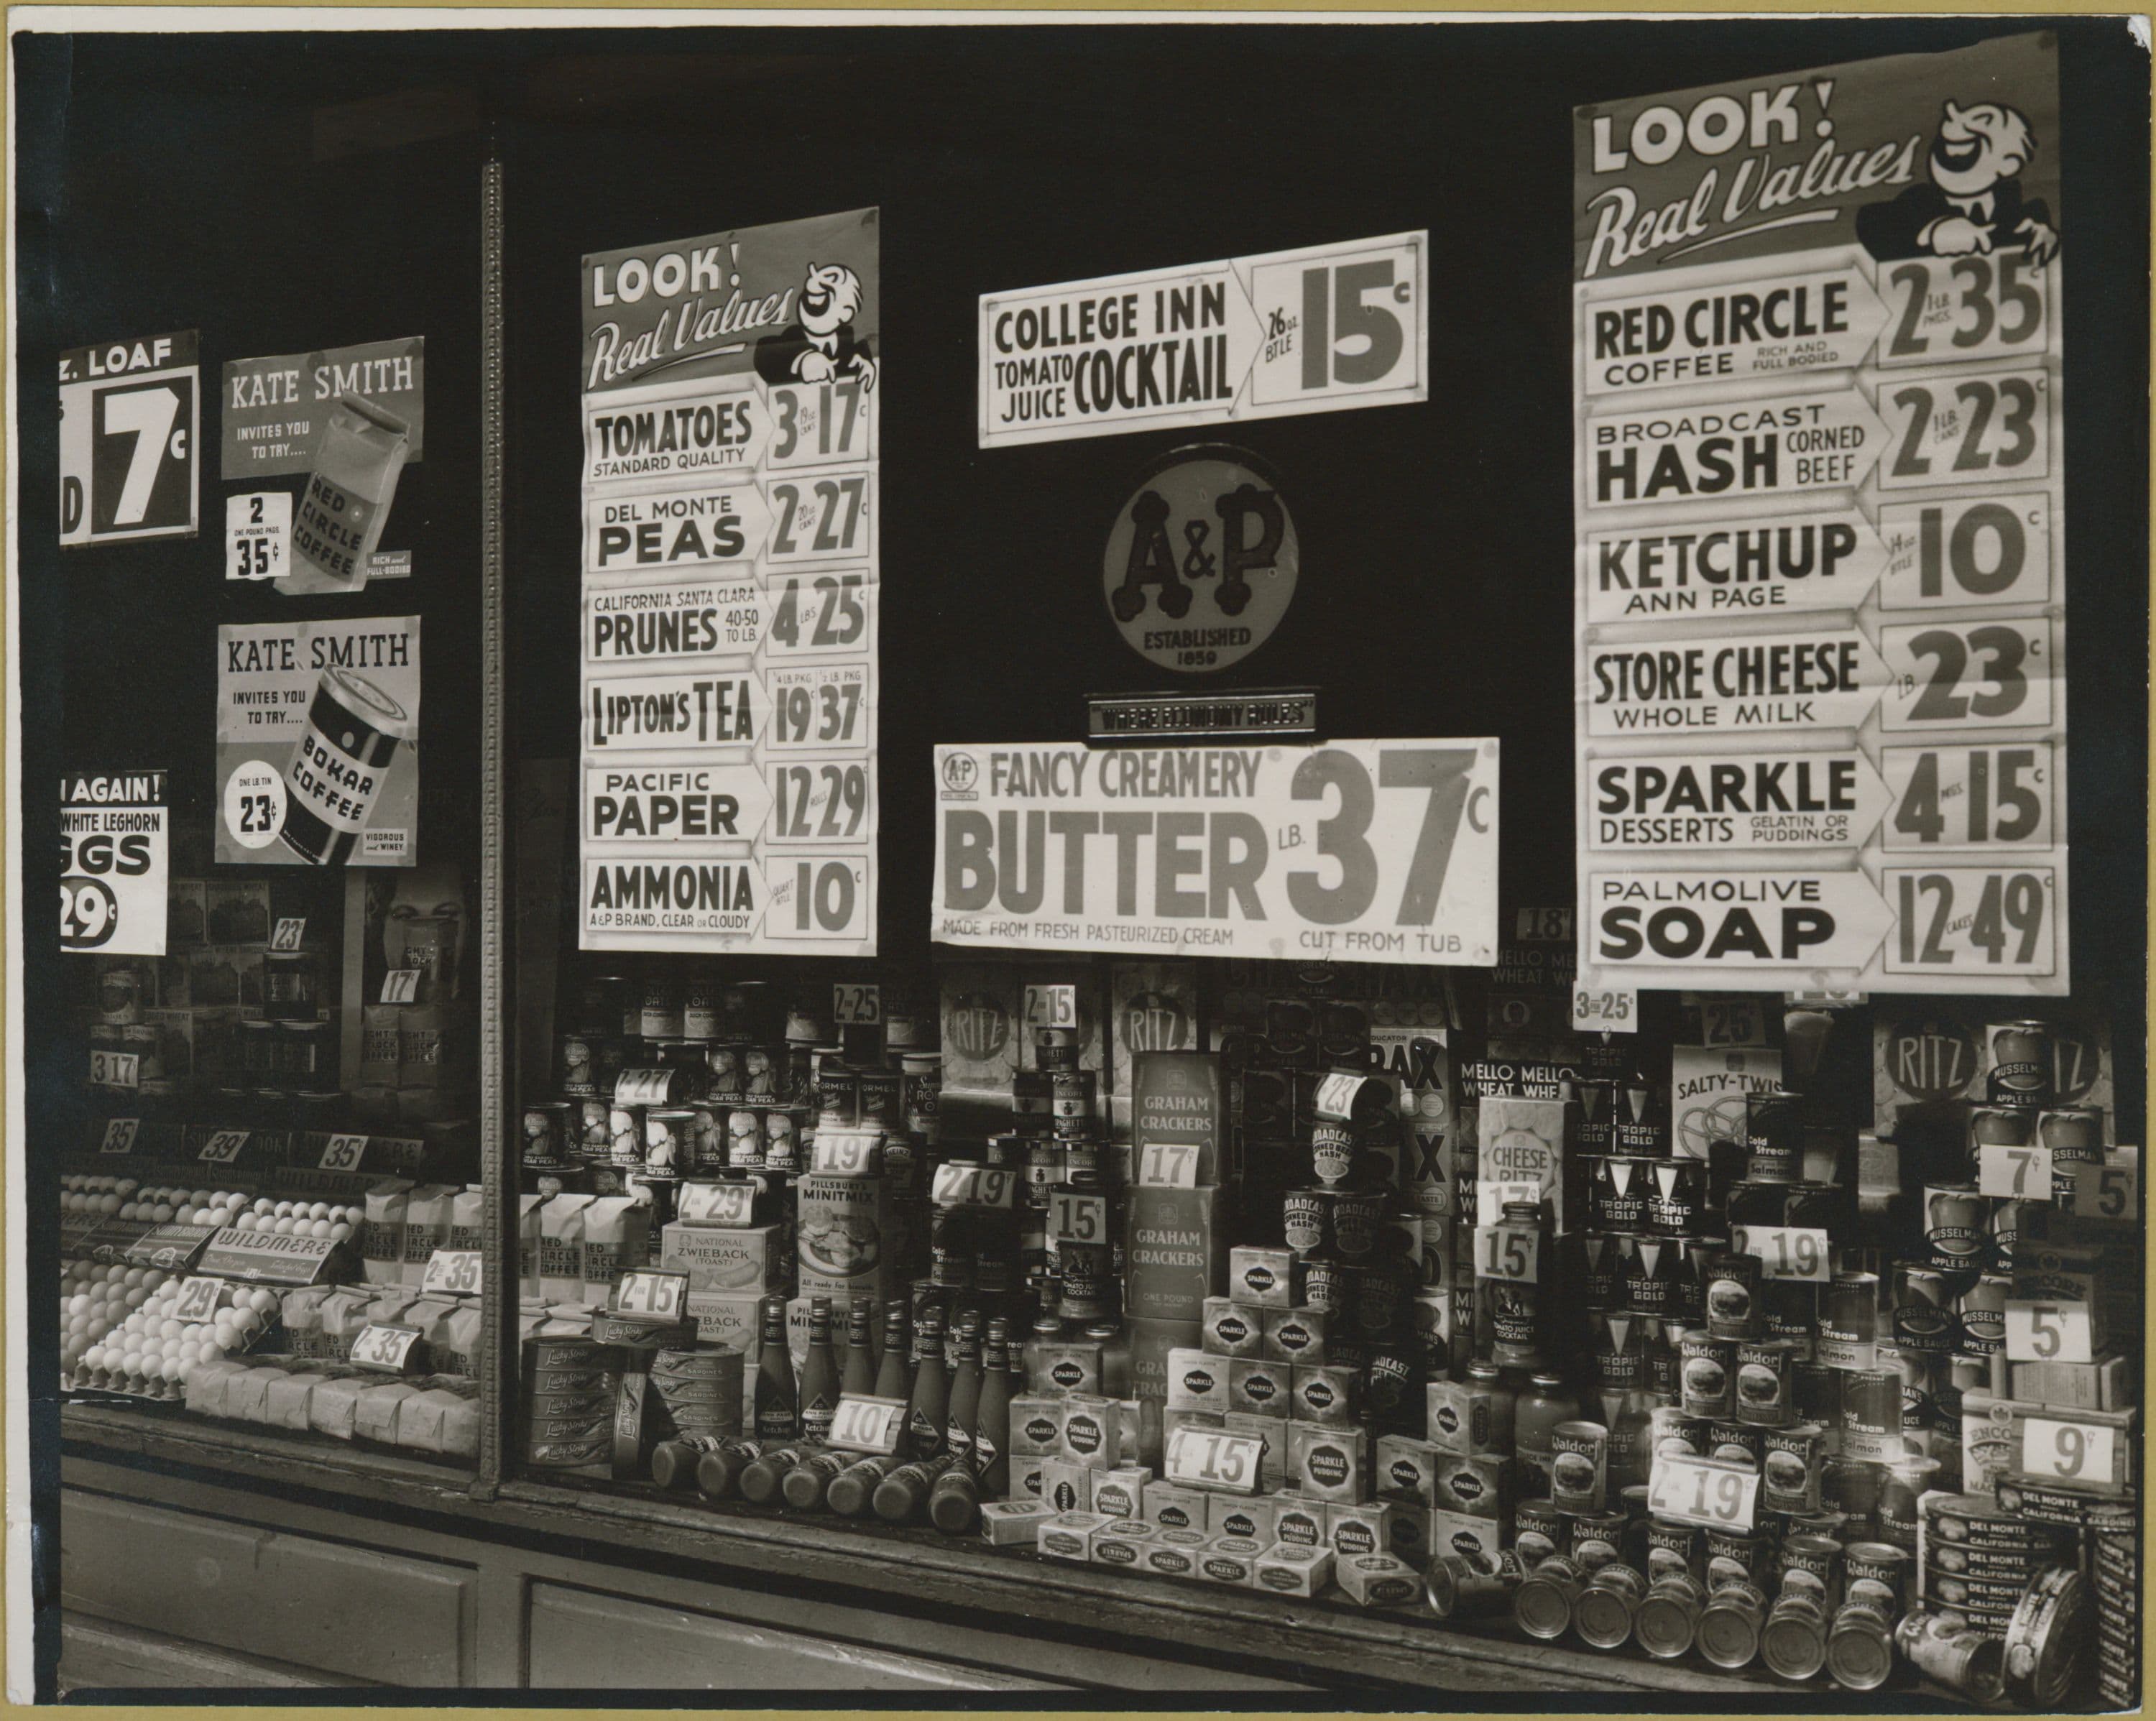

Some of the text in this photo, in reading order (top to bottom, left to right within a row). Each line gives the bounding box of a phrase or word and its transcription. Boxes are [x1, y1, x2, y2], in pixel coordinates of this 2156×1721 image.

[1593, 80, 1835, 175] LOOK!
[1583, 133, 1921, 279] Real Values
[594, 242, 740, 308] LOOK!
[995, 282, 1225, 354] COLLEGE INN
[1594, 281, 1848, 360] RED CIRCLE
[587, 287, 794, 390] Real Values
[1265, 334, 1292, 364] BTLE
[1758, 341, 1828, 358] RICH AND
[88, 338, 173, 377] LOAF
[1604, 352, 1735, 386] COFFEE
[1752, 351, 1838, 371] FULL BODIED
[231, 356, 413, 408] KATE SMITH
[995, 353, 1074, 390] TOMATO
[1075, 333, 1233, 414] COCKTAIL
[1001, 387, 1066, 423] JUICE
[237, 421, 310, 440] INVITES YOU
[596, 400, 751, 458] TOMATOES
[1596, 404, 1825, 445] BROADCAST
[1786, 425, 1865, 453] CORNED
[252, 446, 267, 459] TO
[594, 448, 745, 477] STANDARD QUALITY
[1596, 433, 1778, 502] HASH
[1797, 453, 1856, 484] BEEF
[311, 477, 346, 513] RED
[249, 497, 264, 523] 2
[605, 495, 732, 523] DEL MONTE
[234, 528, 244, 537] ONE
[246, 527, 264, 536] POUND
[302, 502, 363, 551] CIRCLE
[292, 524, 354, 576] COFFEE
[598, 515, 745, 567] PEAS
[1112, 482, 1285, 623] A&P
[372, 554, 390, 566] RICH
[1599, 522, 1857, 591] KETCHUP
[594, 587, 755, 612] CALIFORNIA SANTA CLARA
[1625, 585, 1787, 614] ANN PAGE
[594, 607, 718, 657] PRUNES
[726, 629, 740, 642] TO
[1144, 627, 1251, 650] ESTABLISHED
[228, 633, 410, 673] KATE SMITH
[1177, 650, 1217, 665] 1859
[1593, 640, 1859, 704] STORE CHEESE
[233, 690, 305, 705] INVITES YOU
[248, 711, 262, 724] TO
[693, 680, 753, 742] TEA
[1164, 704, 1244, 729] ECONOMY
[1614, 701, 1816, 729] WHOLE MILK
[303, 734, 374, 797] BOKAR
[990, 749, 1263, 798] FANCY CREAMERY
[239, 778, 252, 788] ONE
[262, 777, 272, 786] TIN
[292, 762, 364, 821] COFFEE
[606, 772, 709, 793] PACIFIC
[1596, 760, 1856, 816] SPARKLE
[60, 813, 160, 833] WHITE LEGHORN
[594, 794, 739, 836] PAPER
[1750, 815, 1848, 829] GELATIN OR
[367, 833, 404, 841] VIGOROUS
[1600, 817, 1734, 844] DESSERTS
[1752, 828, 1848, 843] PUDDINGS
[944, 810, 1268, 921] BUTTER
[590, 865, 754, 911] AMMONIA
[1603, 880, 1821, 902] PALMOLIVE
[662, 914, 694, 928] CLEAR
[708, 914, 750, 928] CLOUDY
[942, 918, 1233, 946] MADE FROM FRESH PASTEURIZED CREAM
[1599, 906, 1836, 960] SOAP
[1299, 931, 1462, 954] CUT FROM TUB
[955, 1010, 1002, 1051] RITZ
[1130, 1008, 1176, 1051] RITZ
[1461, 1063, 1514, 1079] MELLO
[1899, 1035, 1963, 1089] RITZ
[1144, 1096, 1209, 1111] GRAHAM
[1140, 1116, 1212, 1132] CRACKERS
[1493, 1148, 1547, 1168] CHEESE
[803, 1189, 873, 1202] MINITMIX
[1600, 1200, 1644, 1212] TROPIC
[1606, 1210, 1637, 1221] GOLD
[217, 1228, 332, 1256] WILDMERE
[696, 1237, 744, 1247] NATIONAL
[1136, 1229, 1201, 1245] GRAHAM
[677, 1247, 750, 1260] ZWIEBACK
[1133, 1250, 1204, 1267] CRACKERS
[1247, 1274, 1273, 1285] SPARKLE
[1163, 1295, 1194, 1304] POUND
[1219, 1325, 1245, 1337] SPARKLE
[1737, 1348, 1782, 1373] Waldorf
[1054, 1369, 1082, 1380] SPARKLE
[1848, 1421, 1885, 1434] Stream
[1552, 1436, 1600, 1459] Waldorf
[1765, 1436, 1812, 1459] Waldorf
[1312, 1456, 1345, 1469] SPARKLE
[1314, 1466, 1343, 1478] PUDDING
[1970, 1522, 2026, 1534] DEL MONTE
[1970, 1538, 2029, 1550] CALIFORNIA
